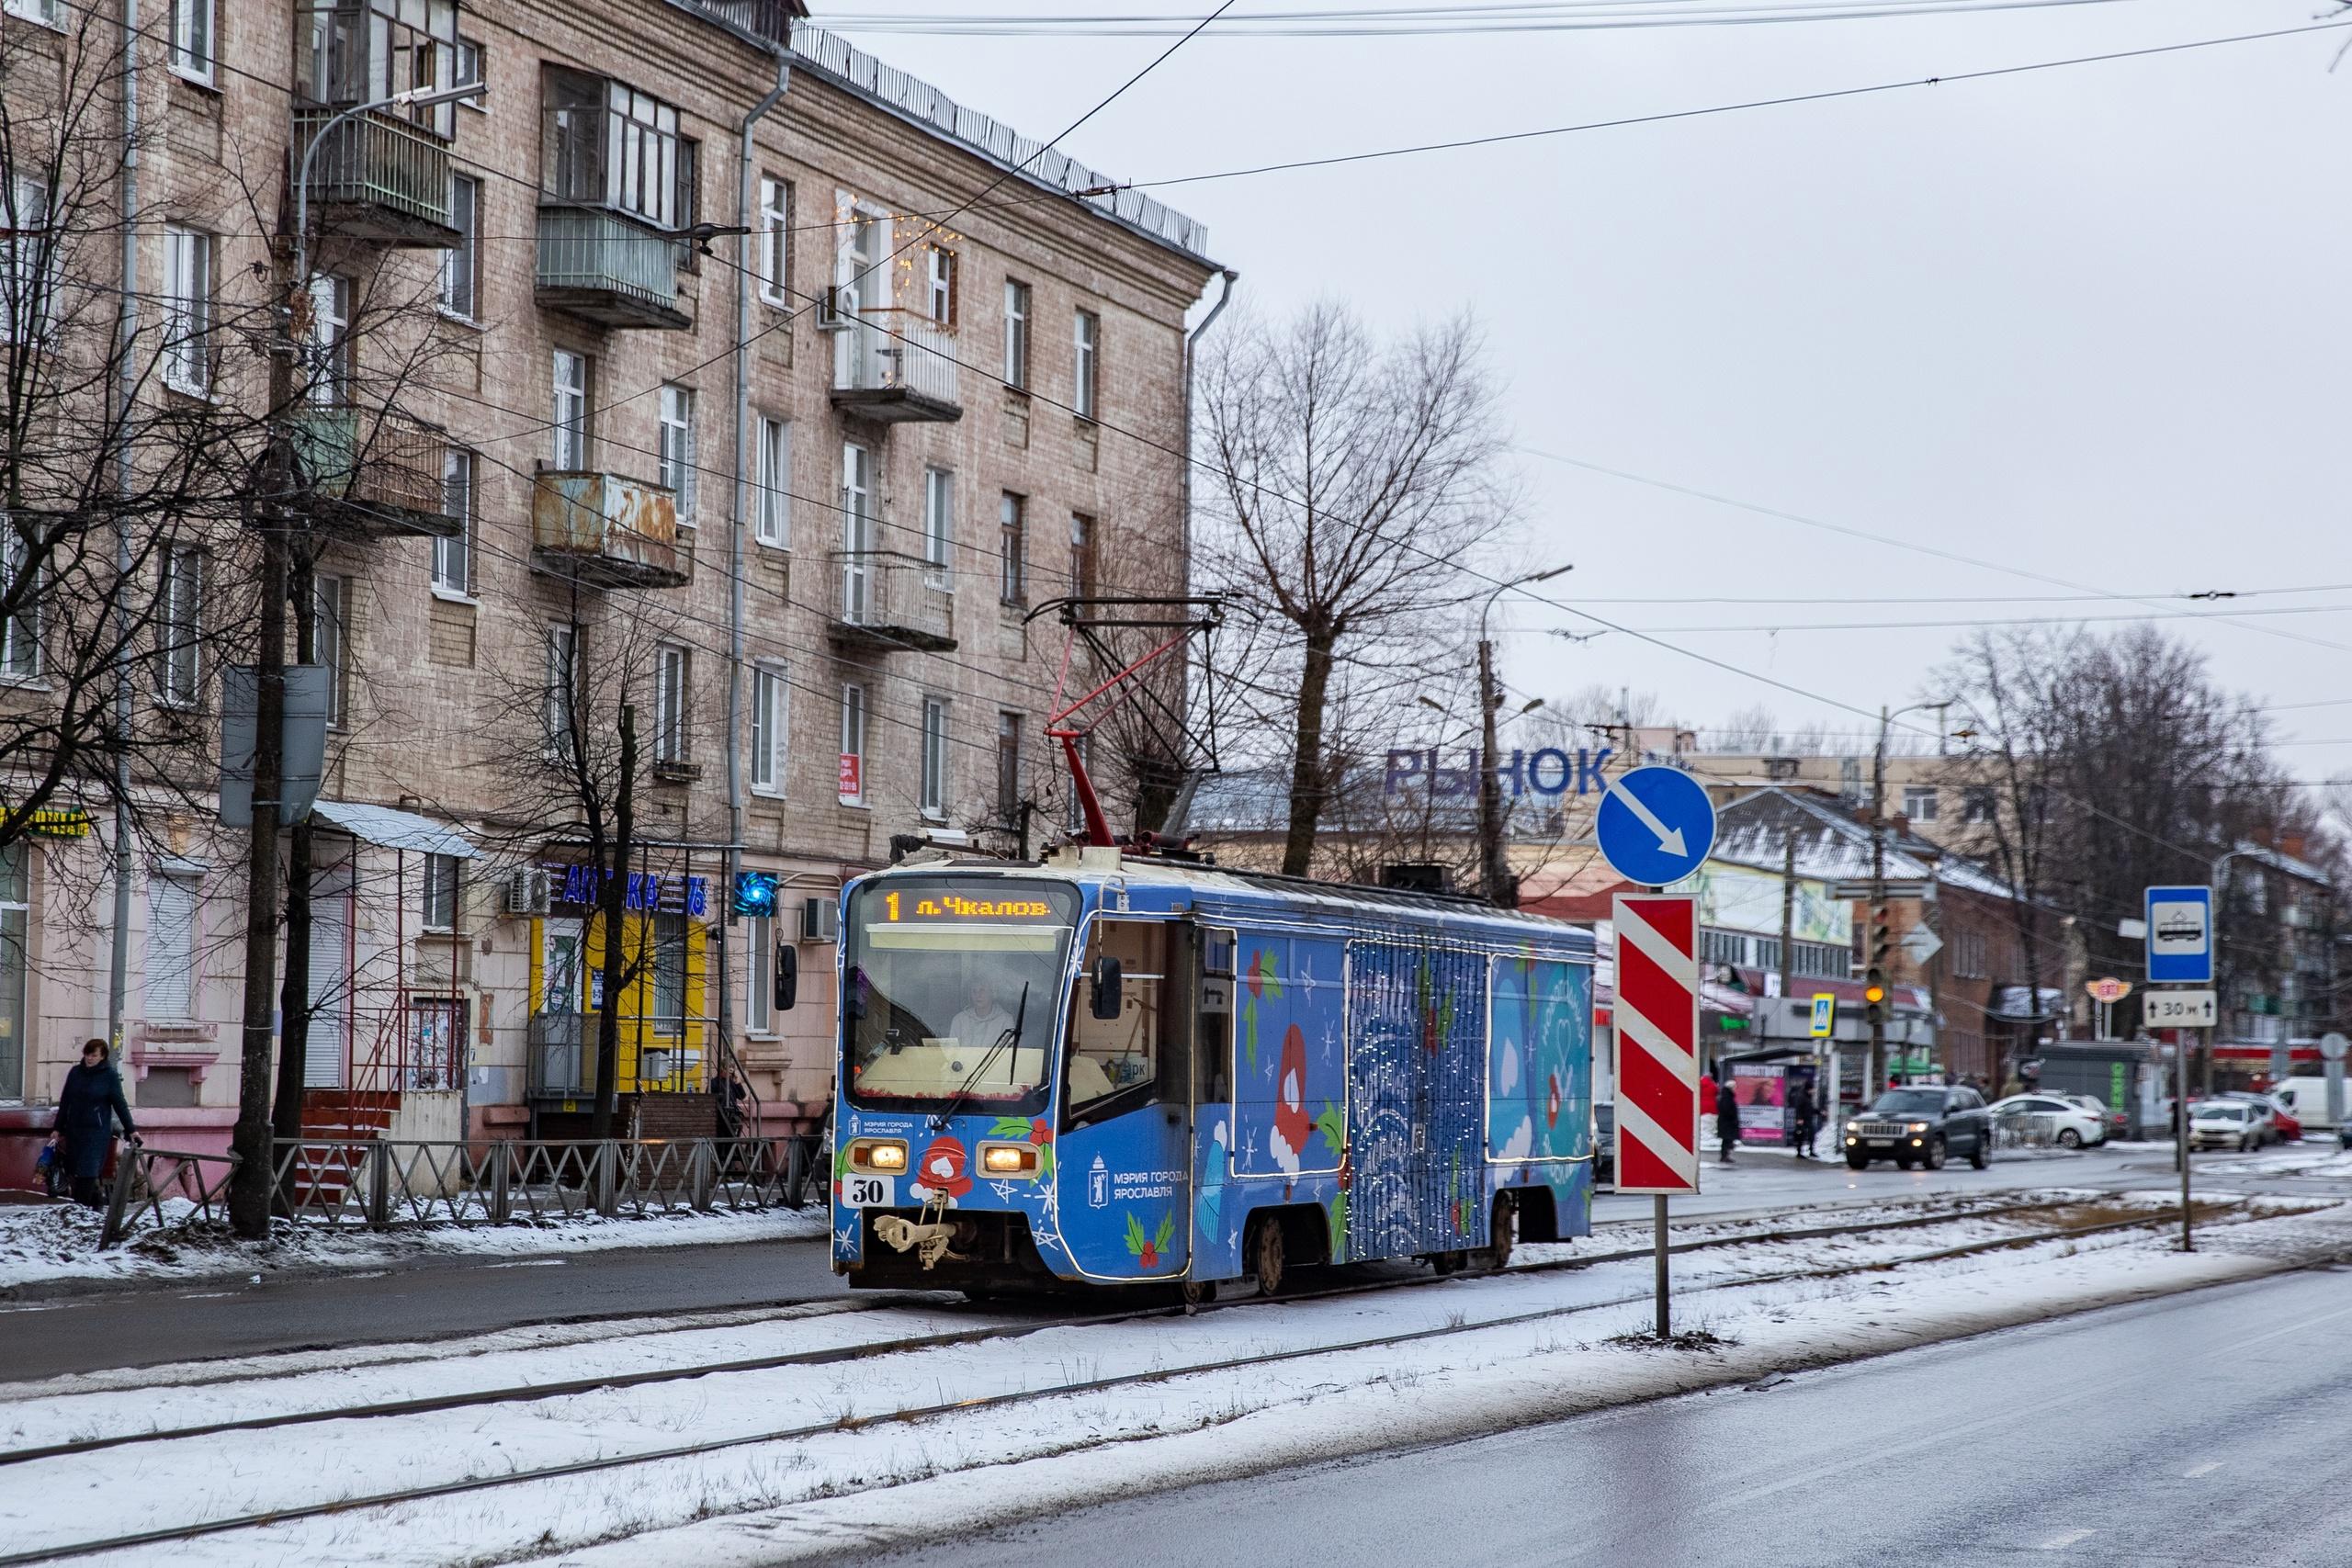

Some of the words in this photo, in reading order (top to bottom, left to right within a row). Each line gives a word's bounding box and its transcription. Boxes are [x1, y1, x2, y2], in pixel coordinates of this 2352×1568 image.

[1386, 747, 1612, 795] РЫНОК
[886, 892, 899, 920] 1
[2163, 1001, 2185, 1016] 30
[1114, 1172, 1148, 1184] МЭРИЯ
[1150, 1170, 1189, 1183] ГОРОДА
[853, 1179, 884, 1203] 30
[1114, 1186, 1173, 1200] ЯРОСЛАВЛЯ
